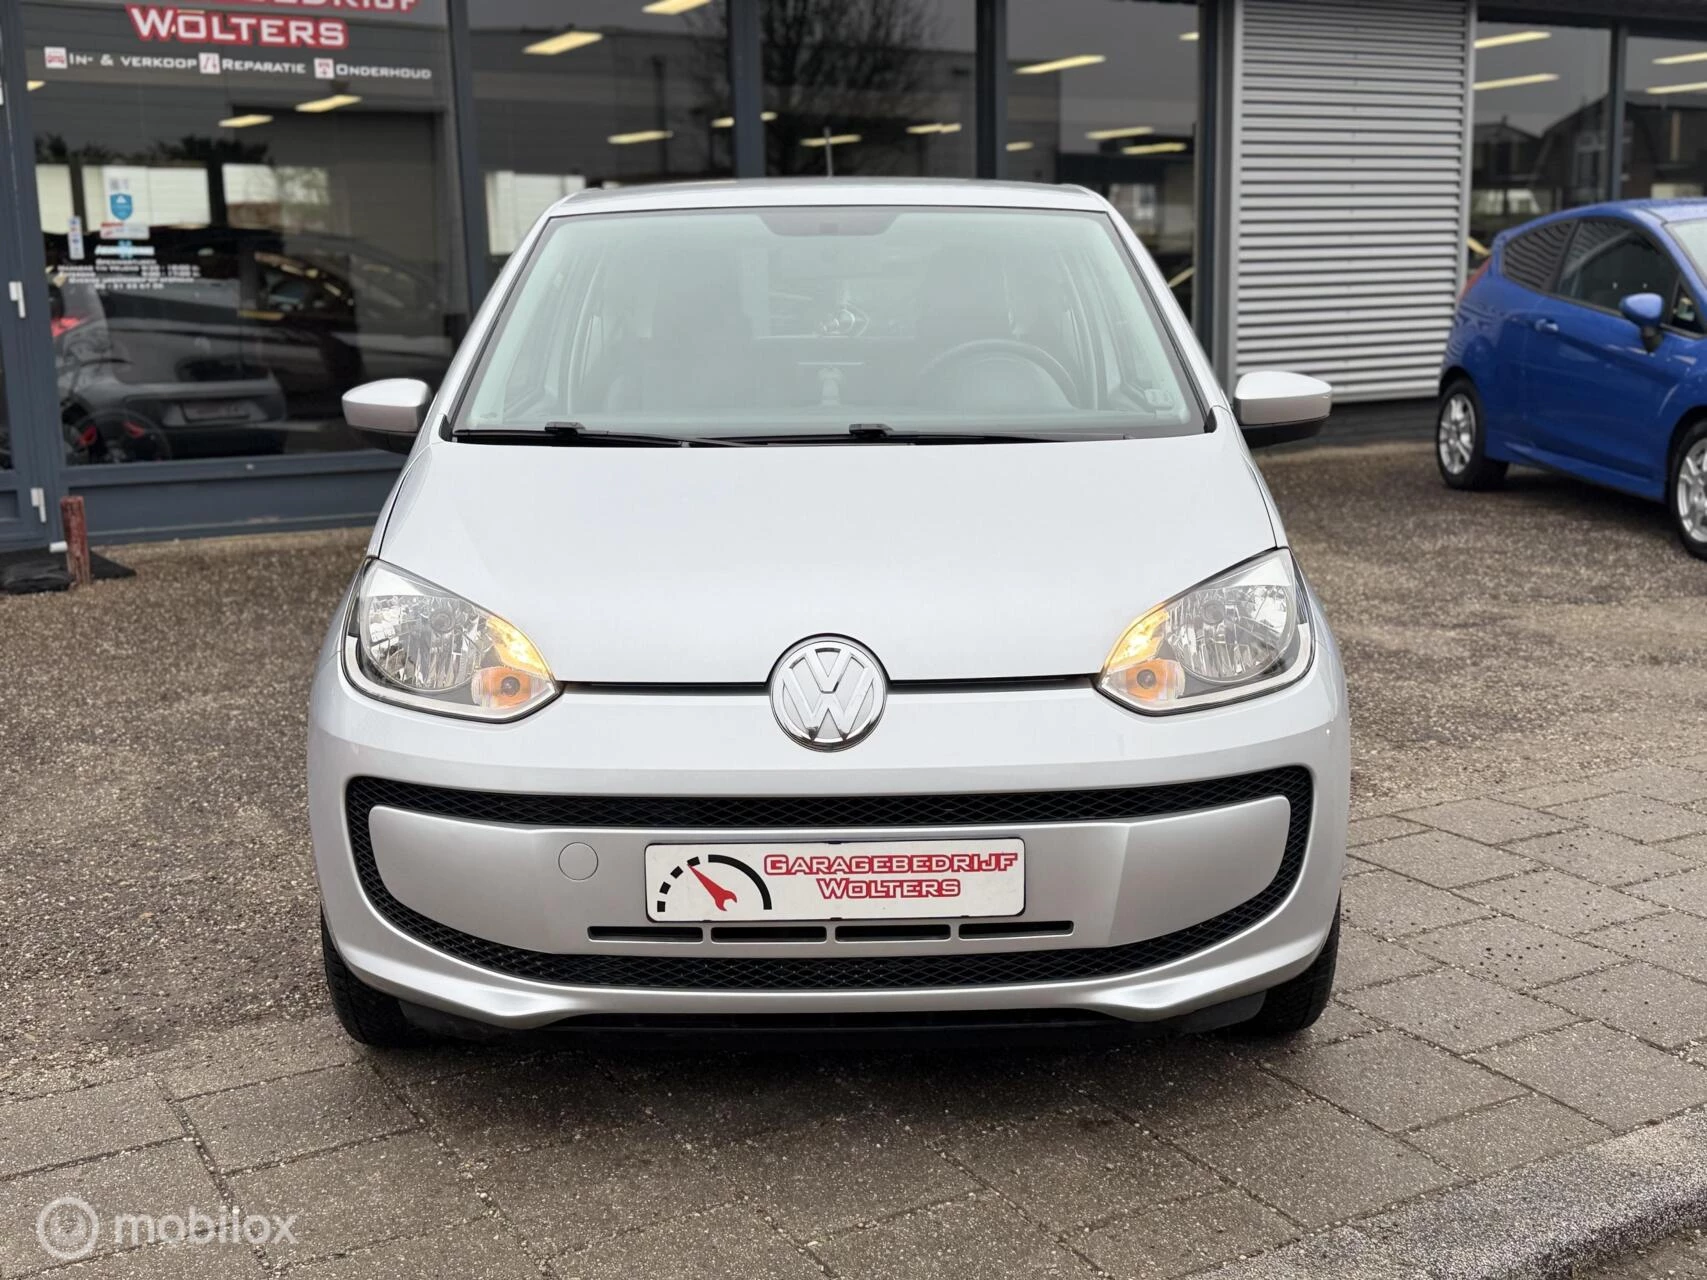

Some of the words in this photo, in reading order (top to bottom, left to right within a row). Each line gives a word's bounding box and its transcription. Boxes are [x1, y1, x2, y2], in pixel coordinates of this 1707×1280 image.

[128, 5, 348, 48] WOLTERS
[100, 53, 114, 66] &
[120, 55, 197, 69] VERKOOP
[222, 59, 306, 74] REPARATIE
[335, 64, 432, 80] ONDERHOUD
[764, 853, 1018, 875] GARAGEBEDRIJF
[816, 878, 960, 899] WOLTERS
